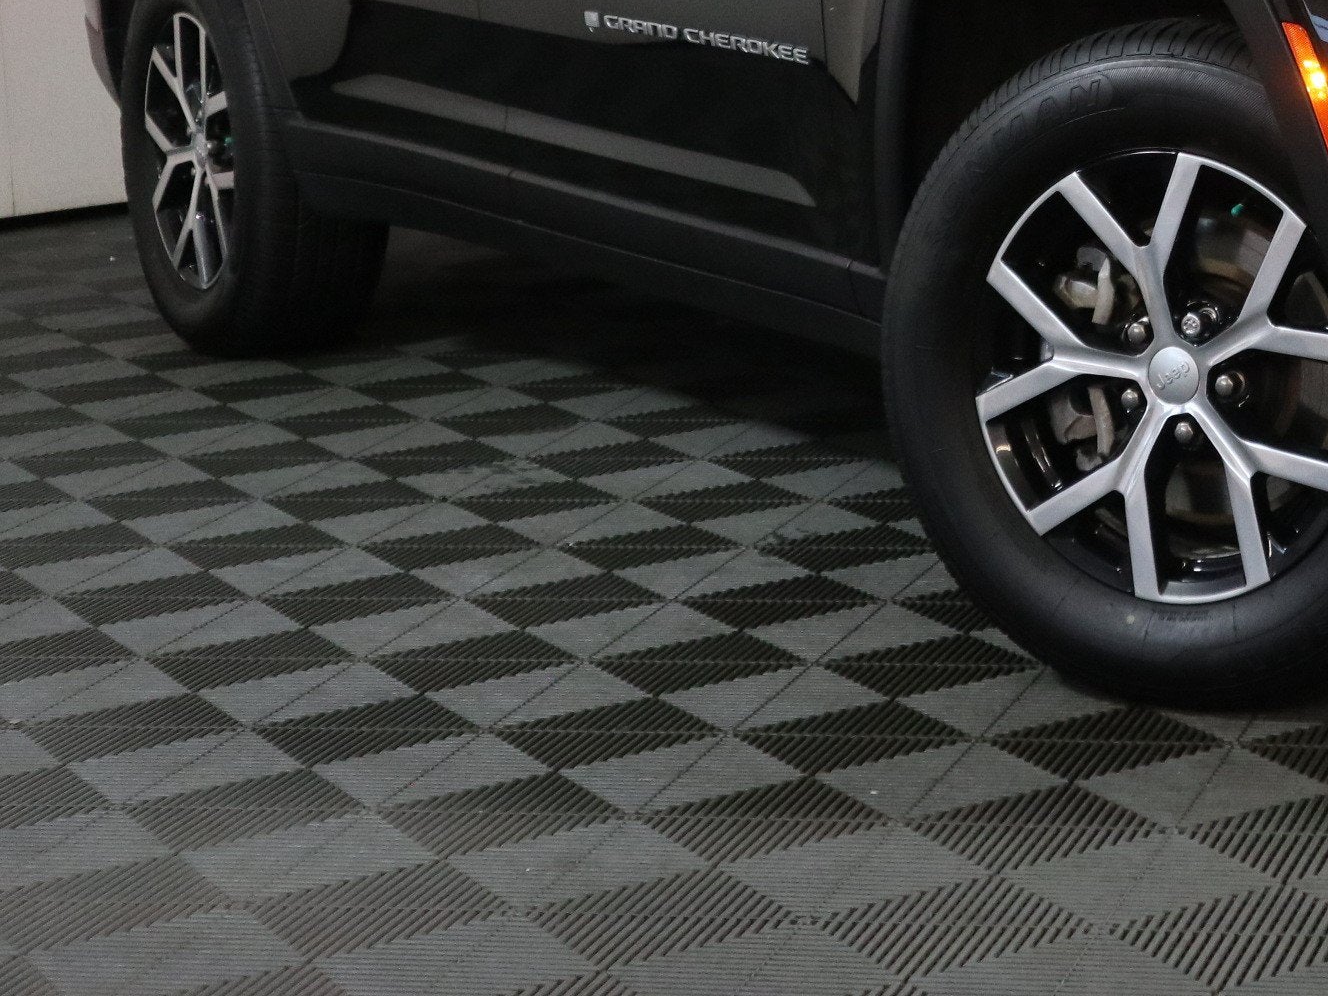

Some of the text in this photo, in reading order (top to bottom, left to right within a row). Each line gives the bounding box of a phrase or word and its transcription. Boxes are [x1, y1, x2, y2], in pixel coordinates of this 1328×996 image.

[603, 14, 809, 65] GRAND CHEROKEE
[1156, 361, 1191, 391] Jeep
